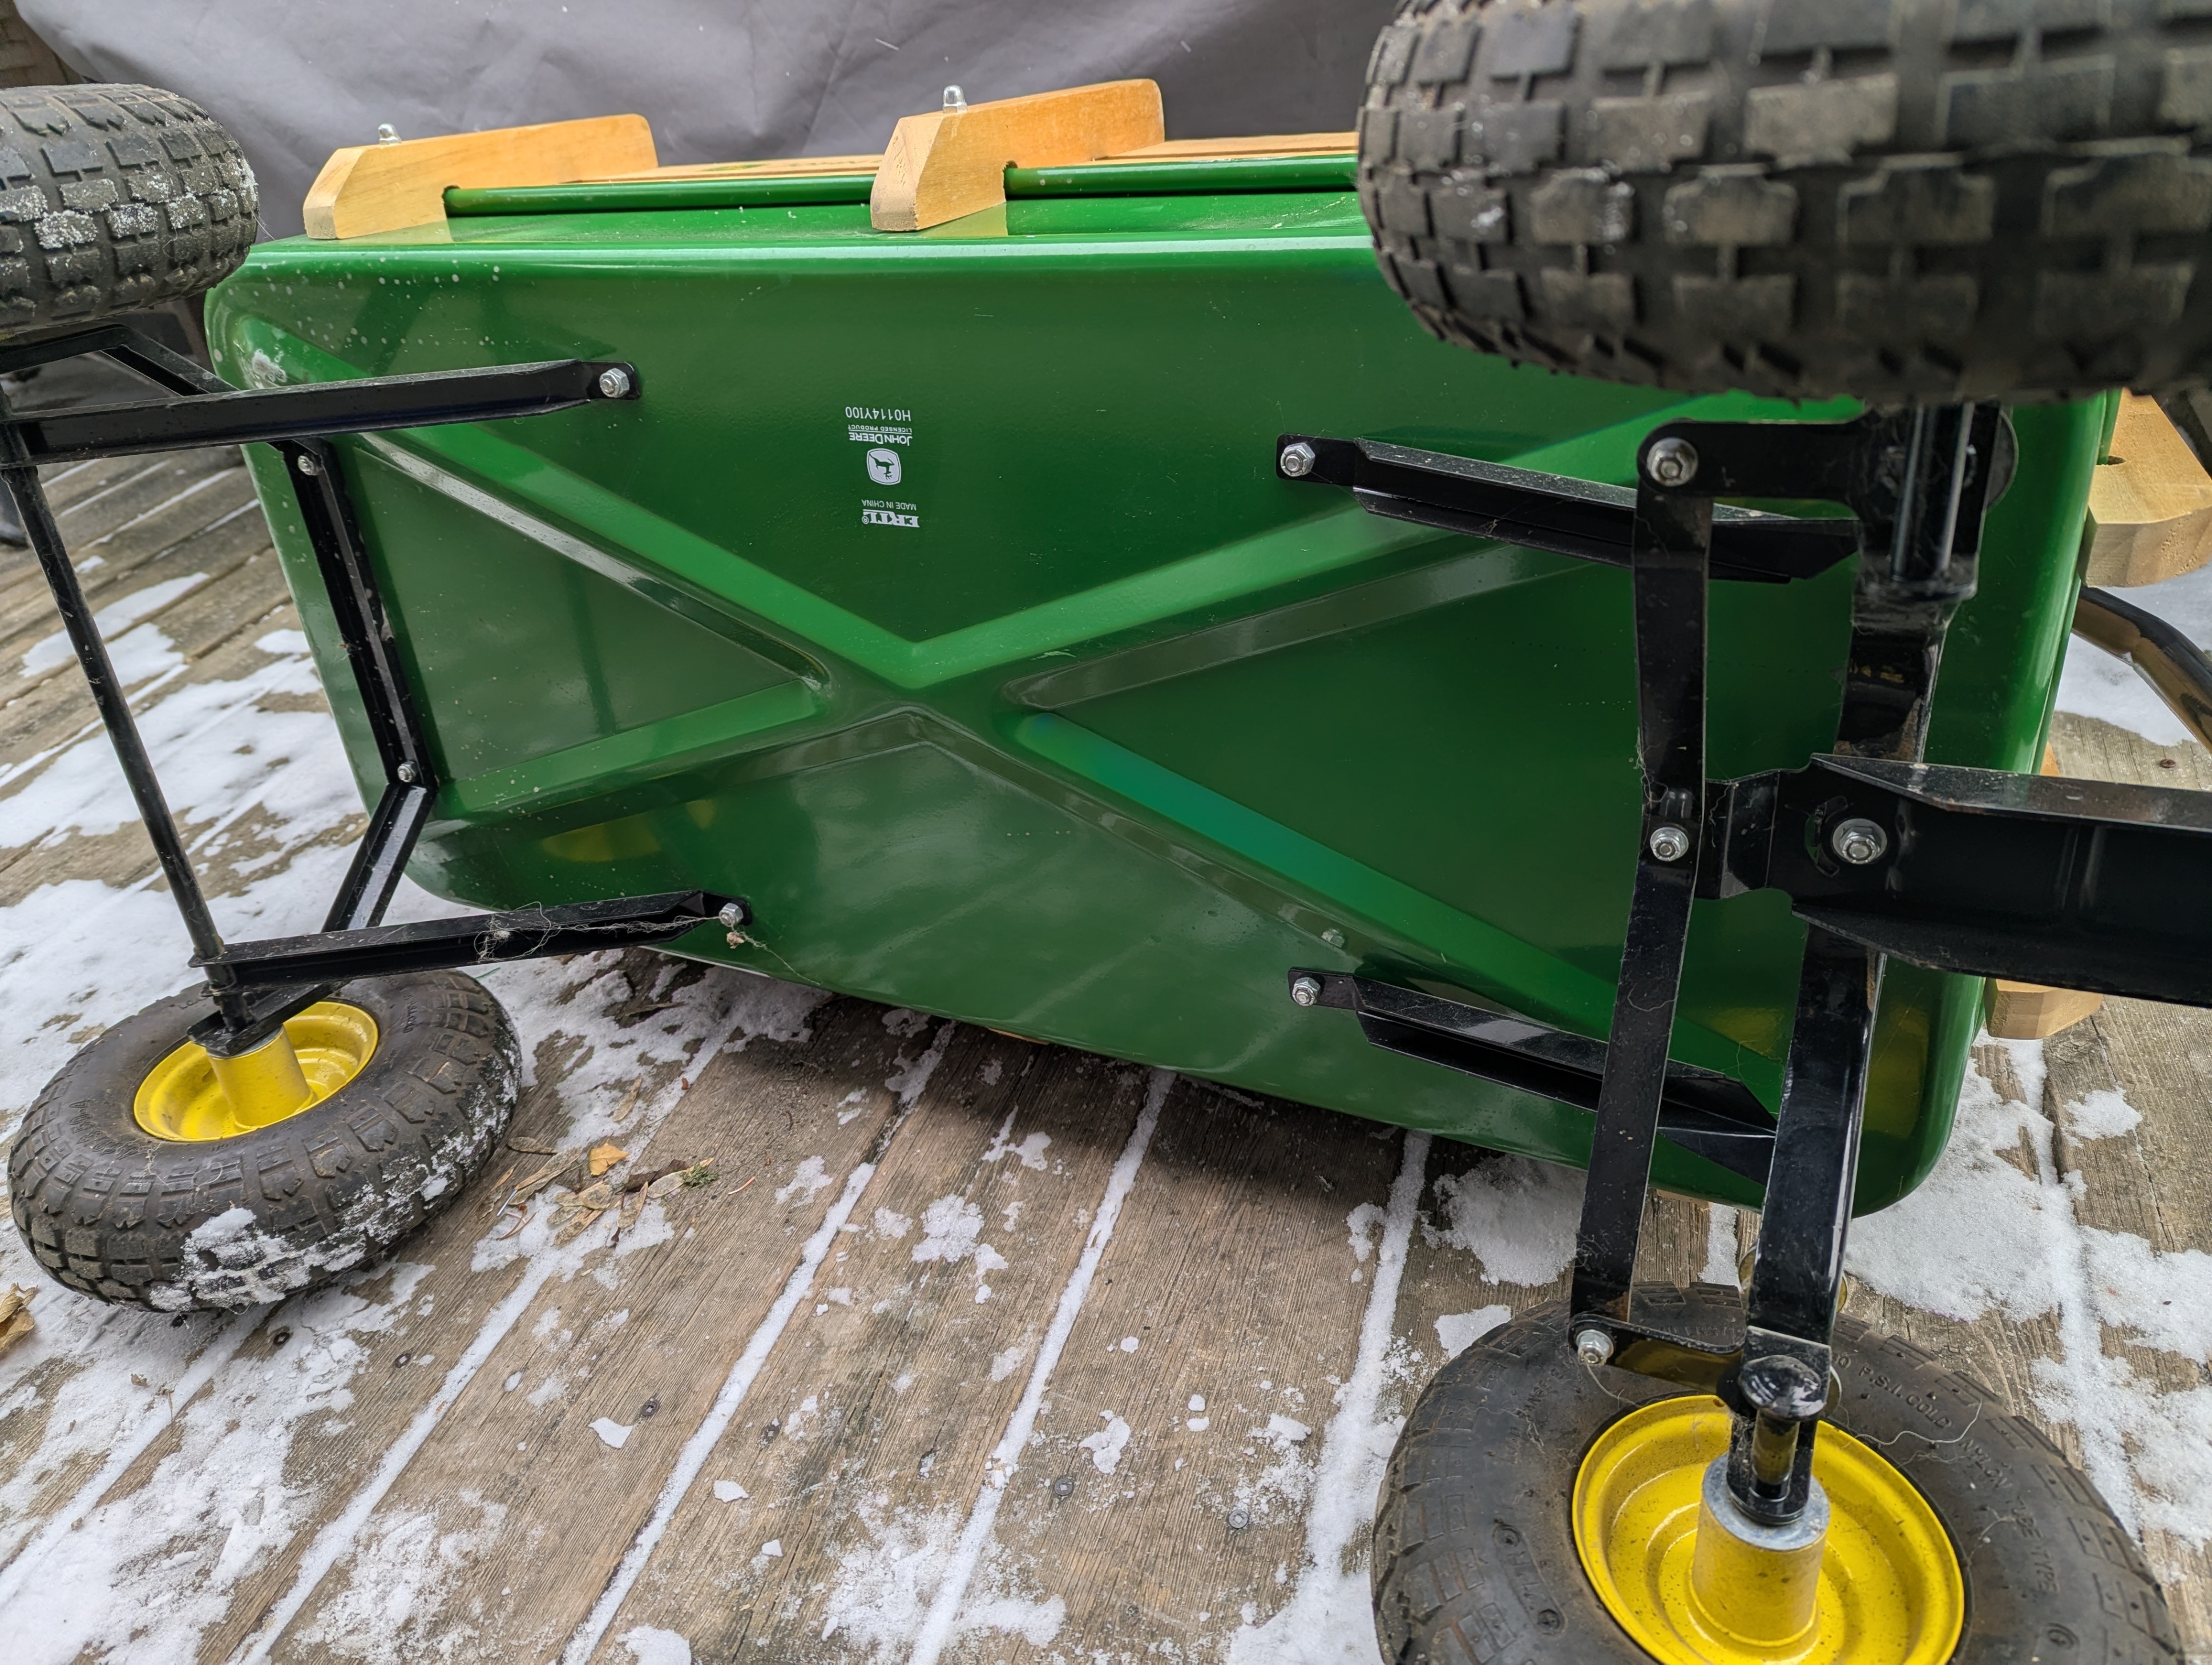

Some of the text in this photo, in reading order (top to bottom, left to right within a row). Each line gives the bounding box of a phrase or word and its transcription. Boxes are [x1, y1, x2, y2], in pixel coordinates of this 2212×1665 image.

[845, 406, 911, 422] H0114YI00
[849, 432, 913, 446] JOHN DEERE
[861, 499, 917, 511] MADE IN CHINA
[1906, 1393, 1952, 1428] COLD
